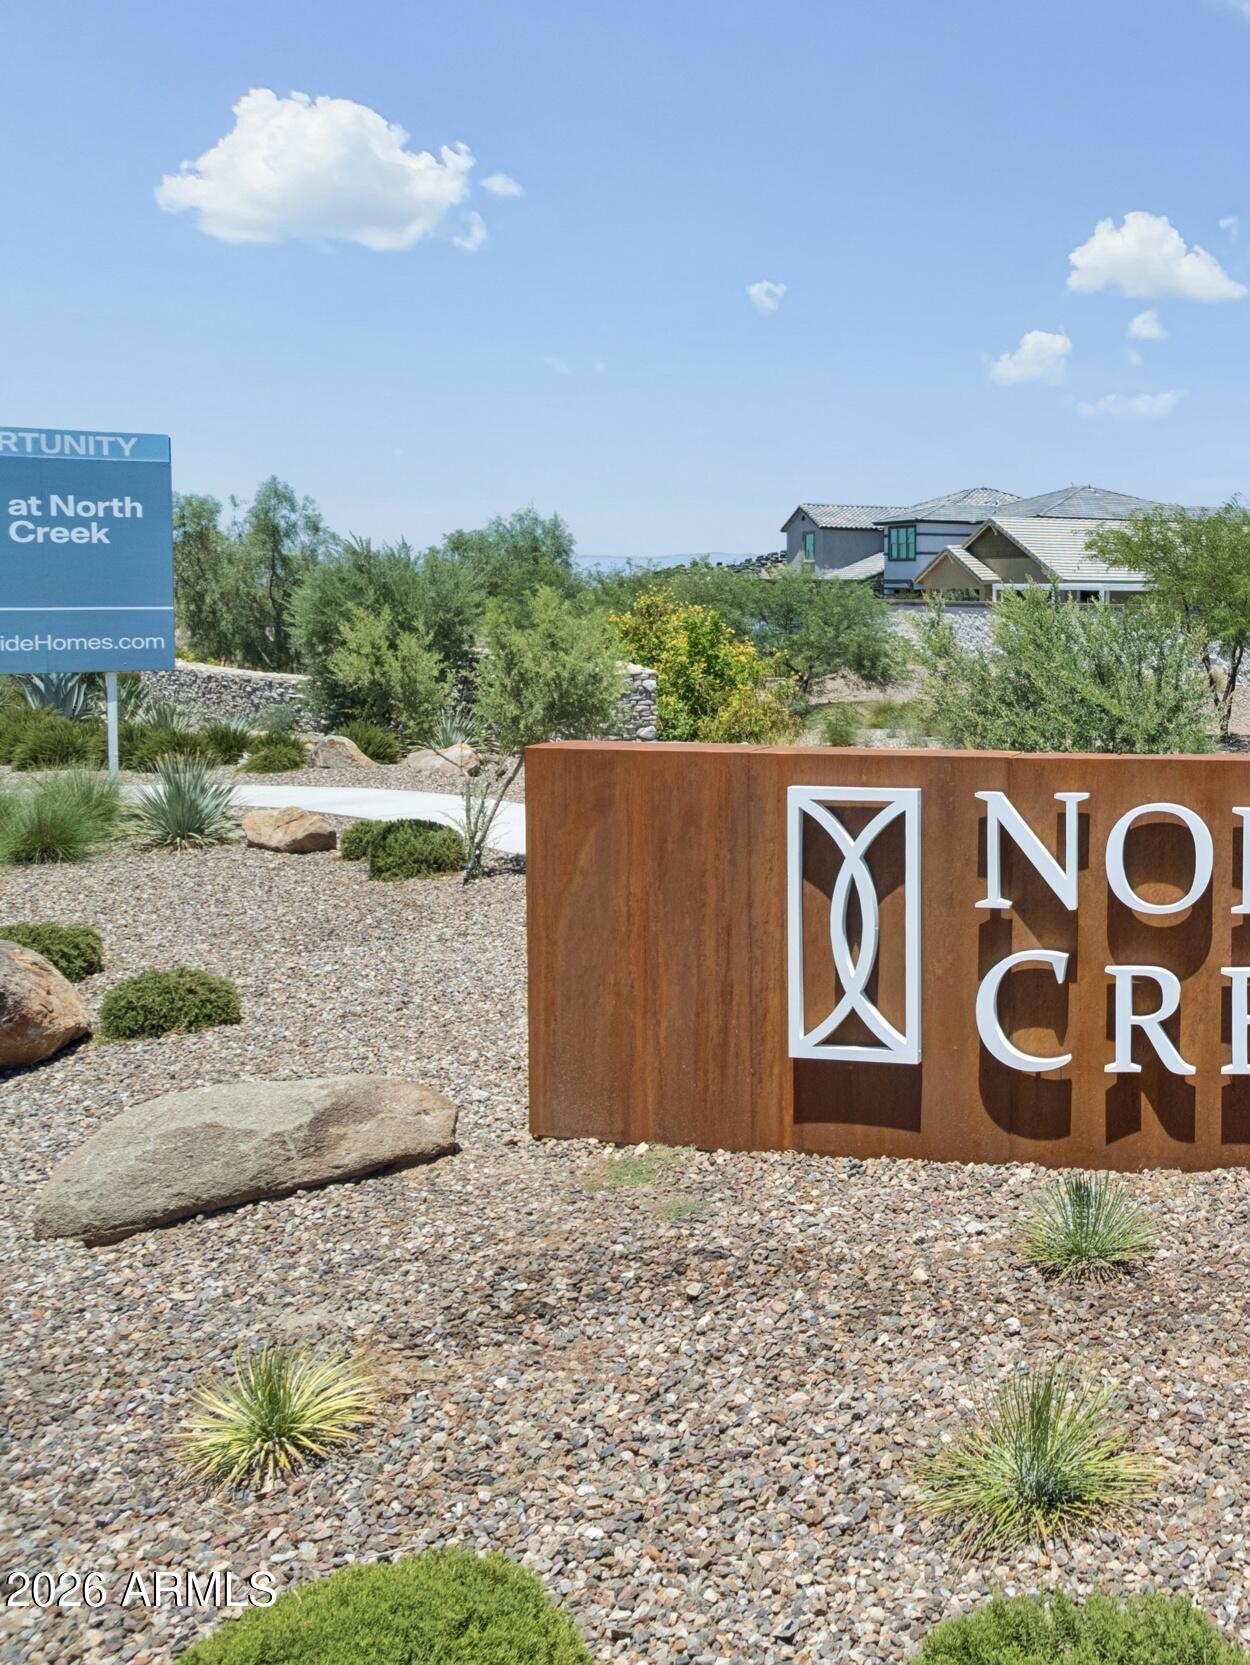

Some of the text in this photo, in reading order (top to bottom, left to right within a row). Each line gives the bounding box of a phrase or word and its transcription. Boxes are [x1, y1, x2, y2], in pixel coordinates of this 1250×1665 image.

[0, 431, 137, 457] RTUNITY
[8, 495, 143, 518] at North
[8, 520, 111, 544] Creek
[0, 634, 165, 651] ideHomes.com
